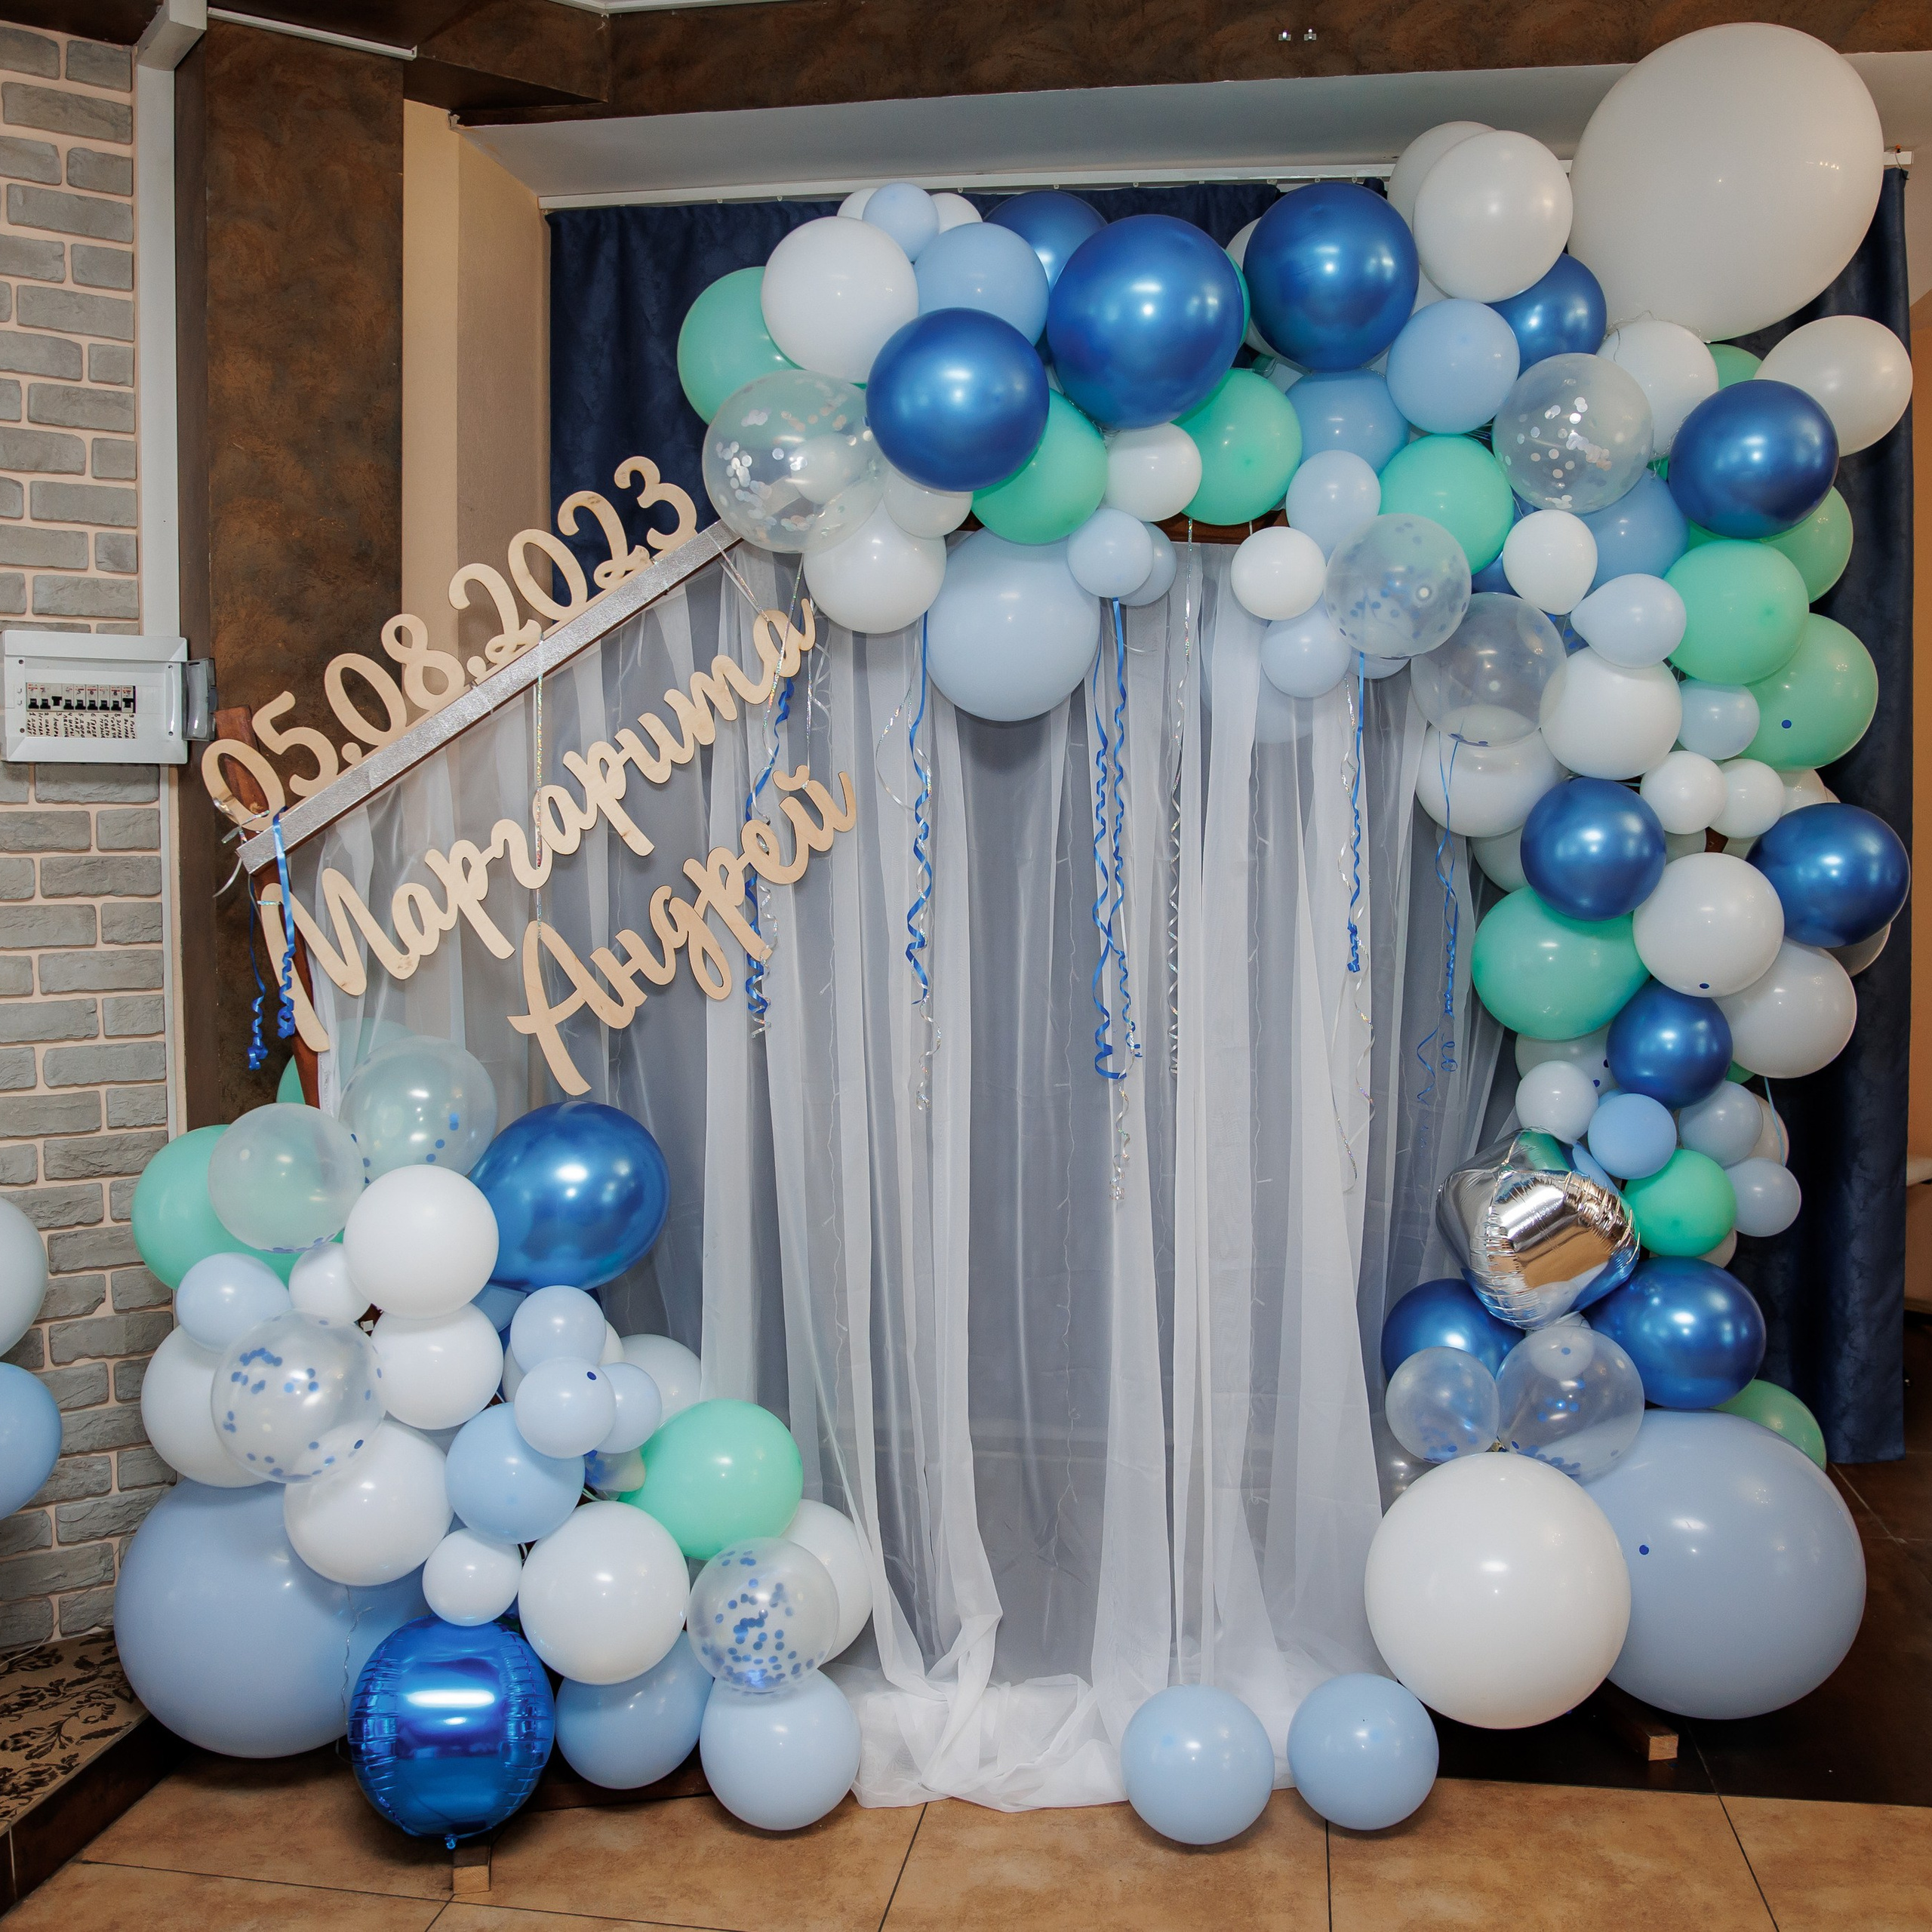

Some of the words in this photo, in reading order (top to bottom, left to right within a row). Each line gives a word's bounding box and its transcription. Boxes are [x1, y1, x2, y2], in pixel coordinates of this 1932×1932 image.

[202, 455, 697, 832] 05.08.2023
[257, 598, 816, 1052] Маргарита
[506, 764, 857, 1096] Андрей
